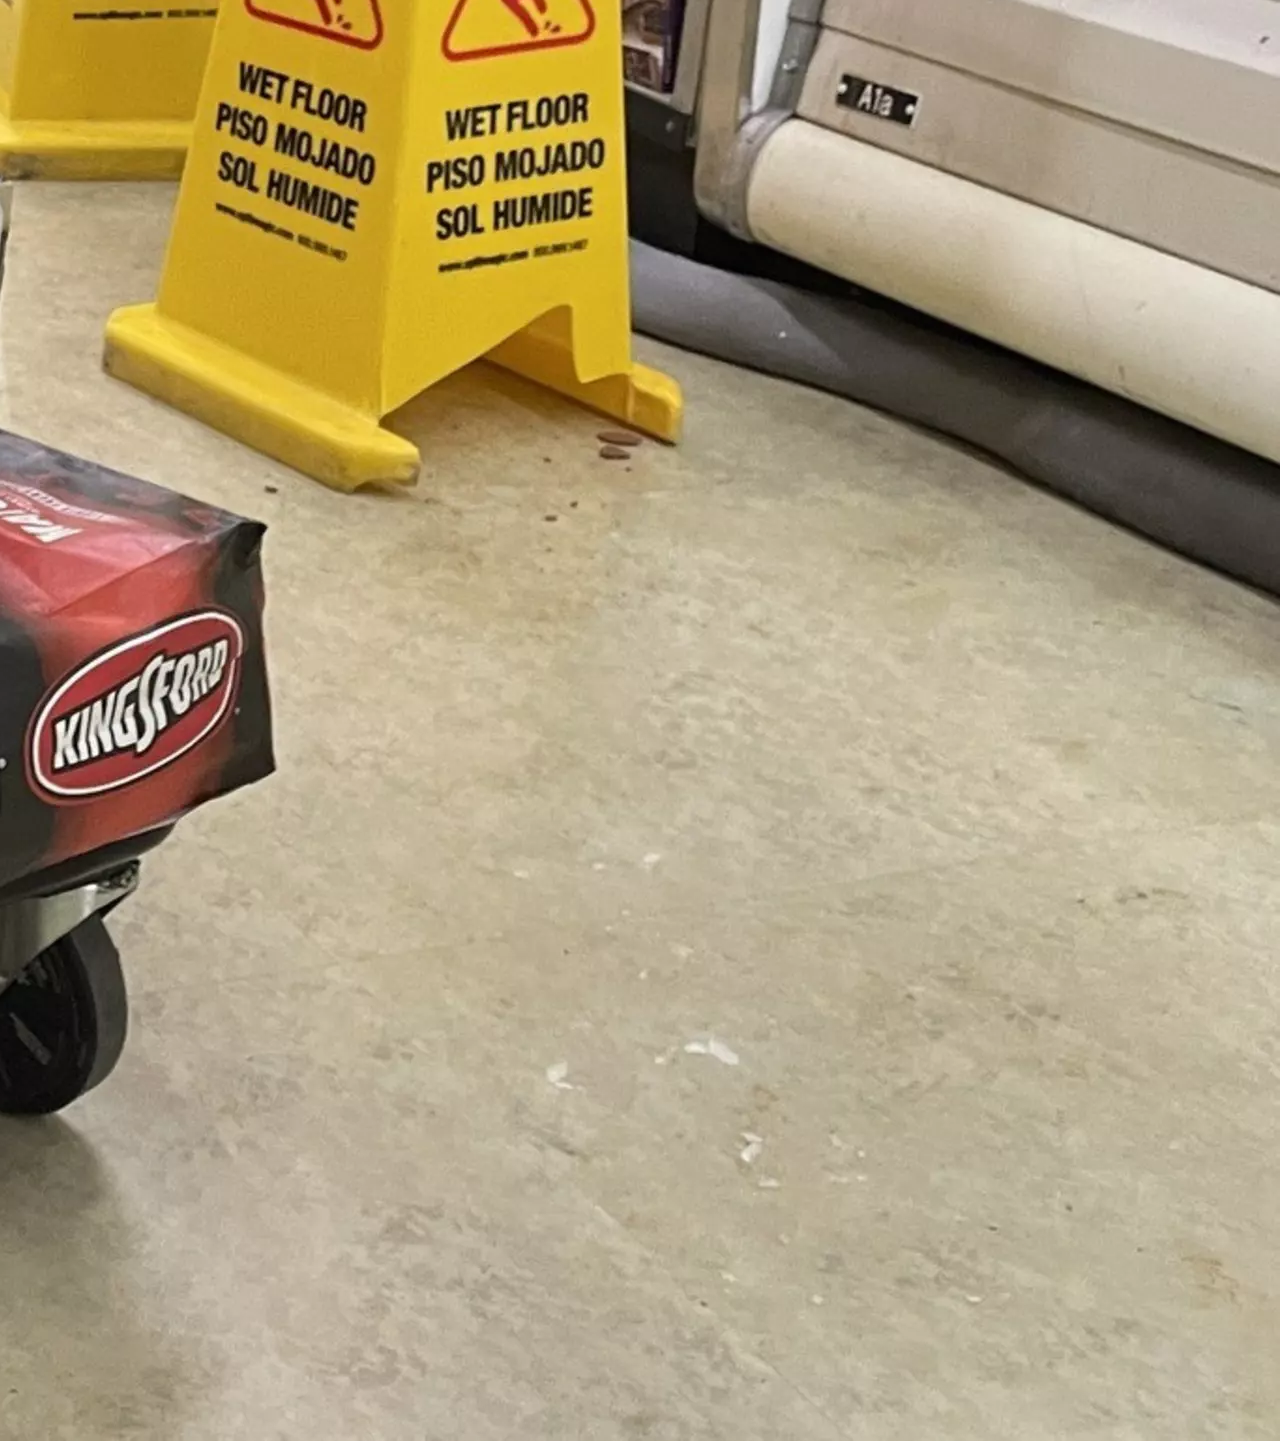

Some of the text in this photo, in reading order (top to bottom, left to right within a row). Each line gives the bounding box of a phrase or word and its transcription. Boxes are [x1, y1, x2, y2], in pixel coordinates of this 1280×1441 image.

[239, 61, 368, 133] WET FLOOR
[445, 93, 590, 142] WET FLOOR
[215, 102, 376, 187] PISO MOJADO
[426, 138, 606, 193] PISO MOJADO
[218, 152, 361, 231] SOL HUMIDE
[435, 187, 594, 241] SOL HUMIDE
[52, 637, 229, 772] KINGSFORD
